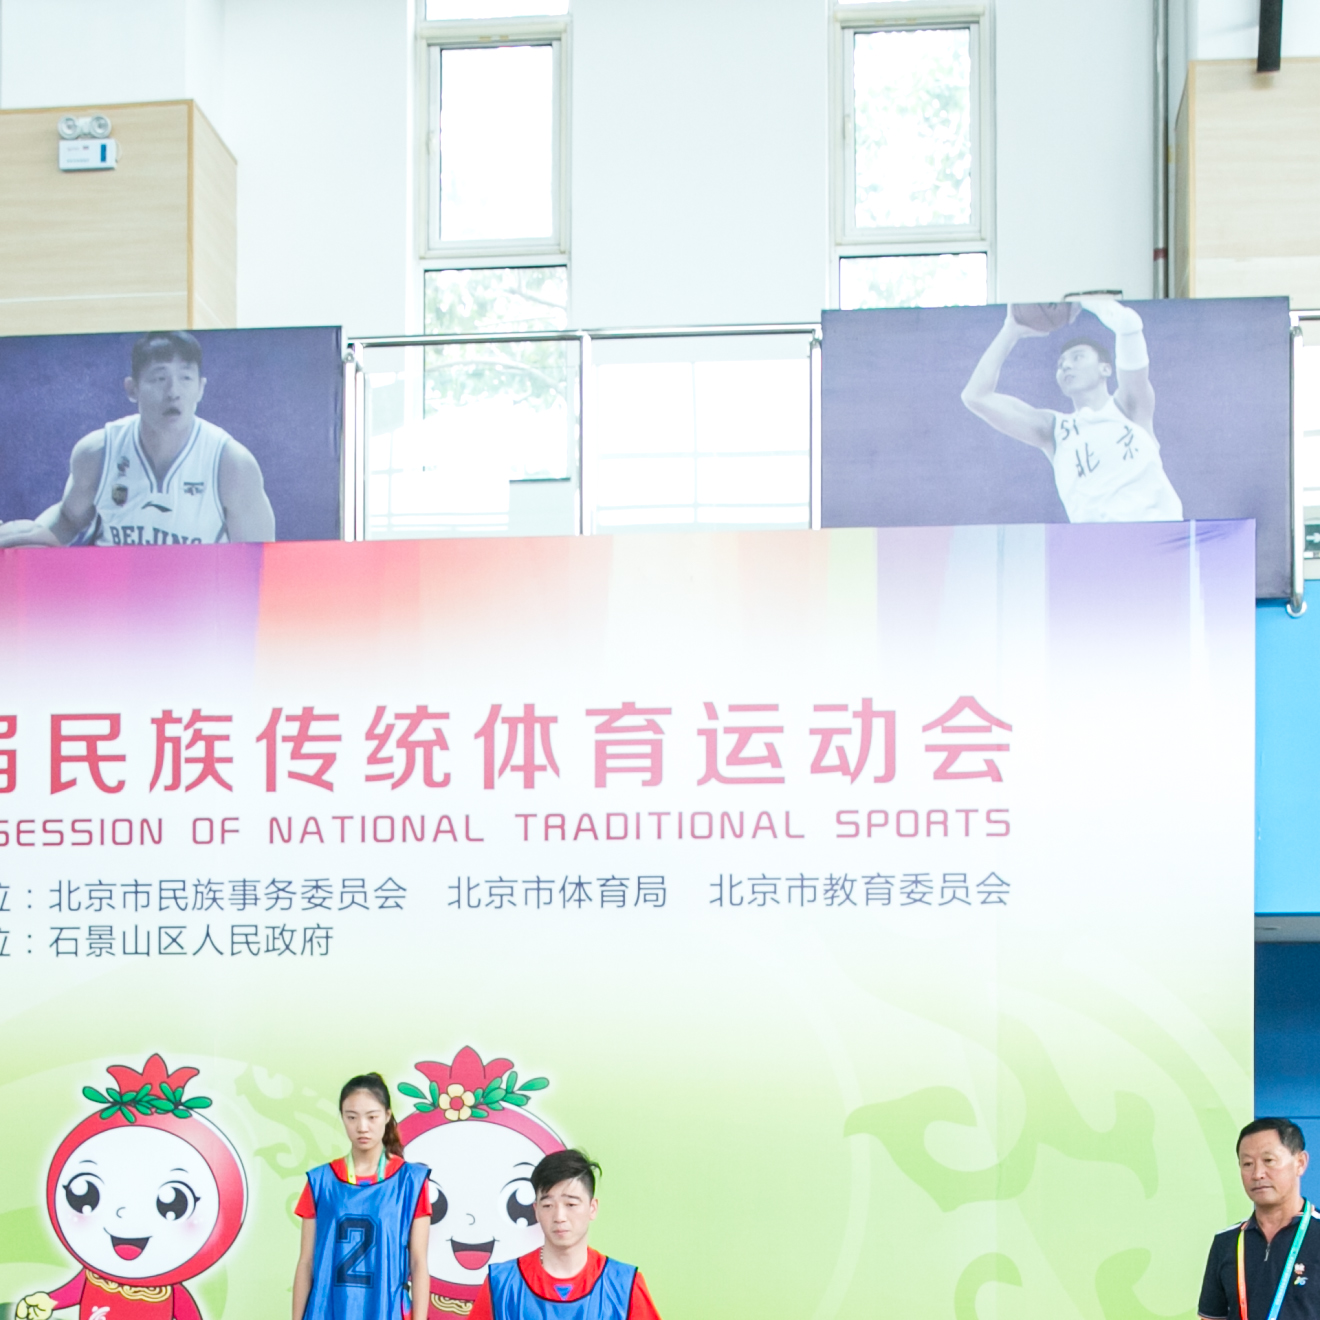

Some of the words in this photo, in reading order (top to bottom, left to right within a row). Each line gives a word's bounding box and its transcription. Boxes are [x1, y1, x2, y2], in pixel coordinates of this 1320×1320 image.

[191, 816, 242, 846] OF
[269, 813, 484, 845] NATIONAL
[515, 810, 806, 842] TRADITIONAL
[835, 808, 1011, 839] SPORTS
[447, 874, 668, 910] 北京市体育局
[708, 871, 1012, 908] 北京市教育委员会
[334, 1214, 378, 1290] 2
